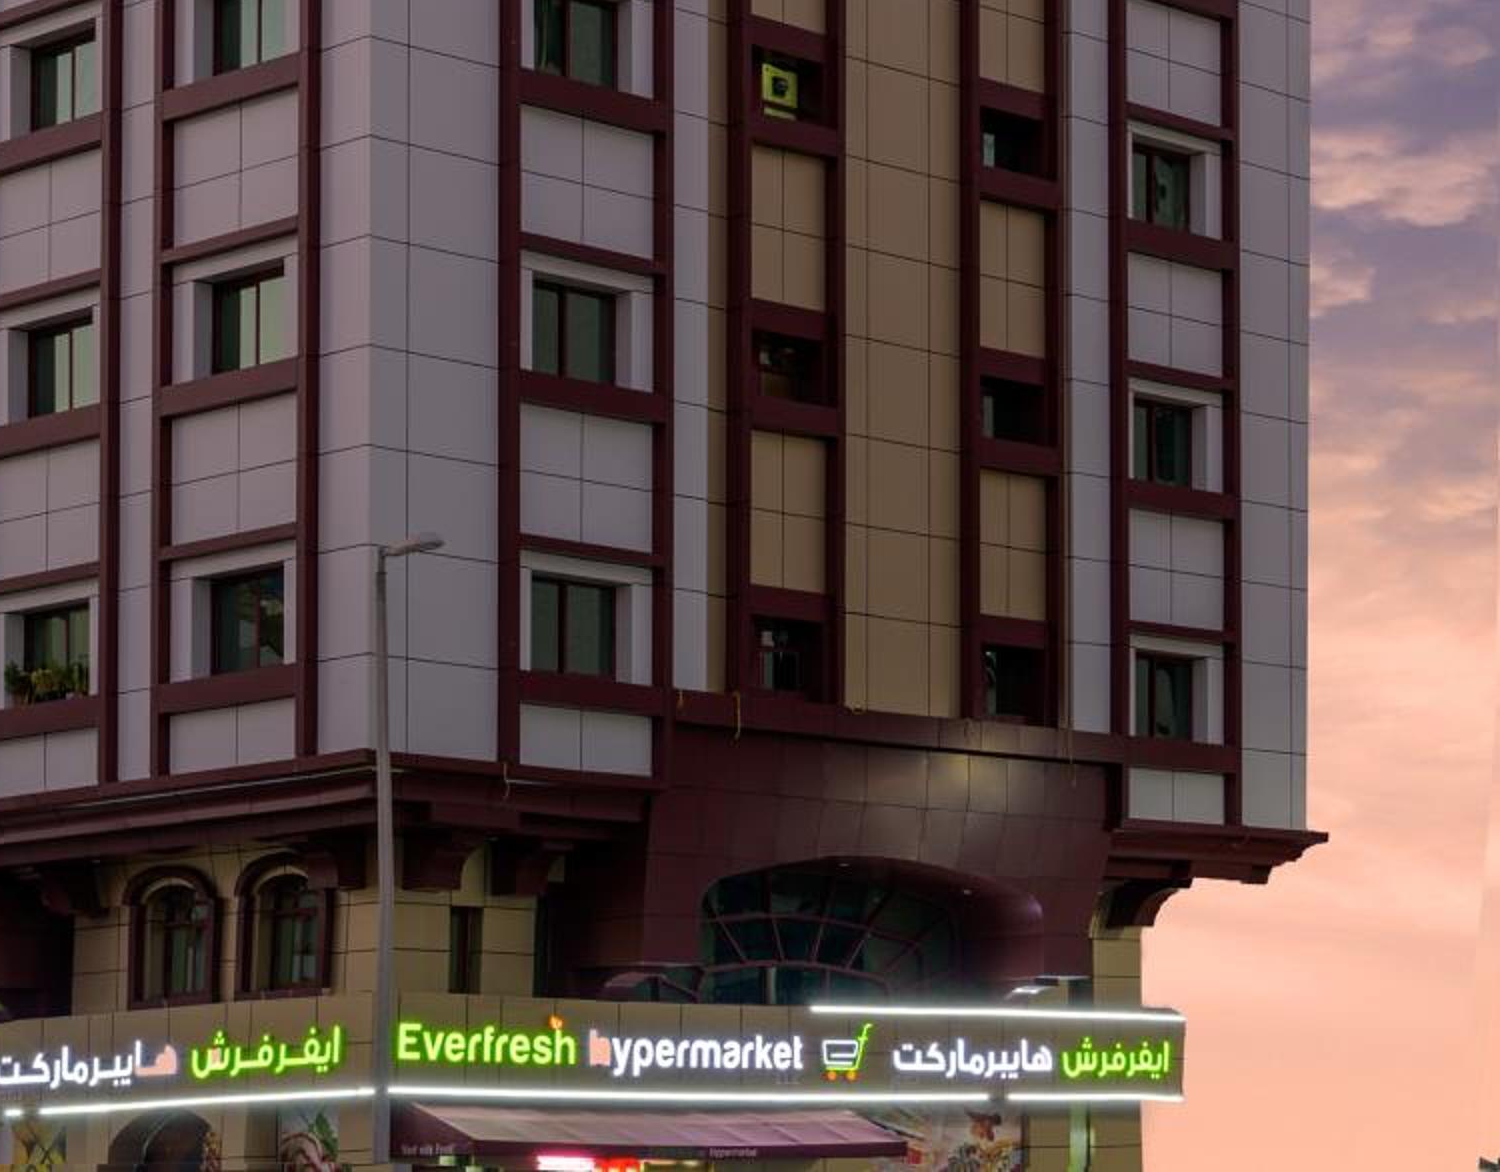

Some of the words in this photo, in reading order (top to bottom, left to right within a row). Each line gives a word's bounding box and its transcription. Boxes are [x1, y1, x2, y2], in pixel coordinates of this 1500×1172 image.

[396, 1022, 577, 1066] Everfresh
[587, 1029, 804, 1078] hypermarket
[892, 1038, 1054, 1079] هايبرماركت
